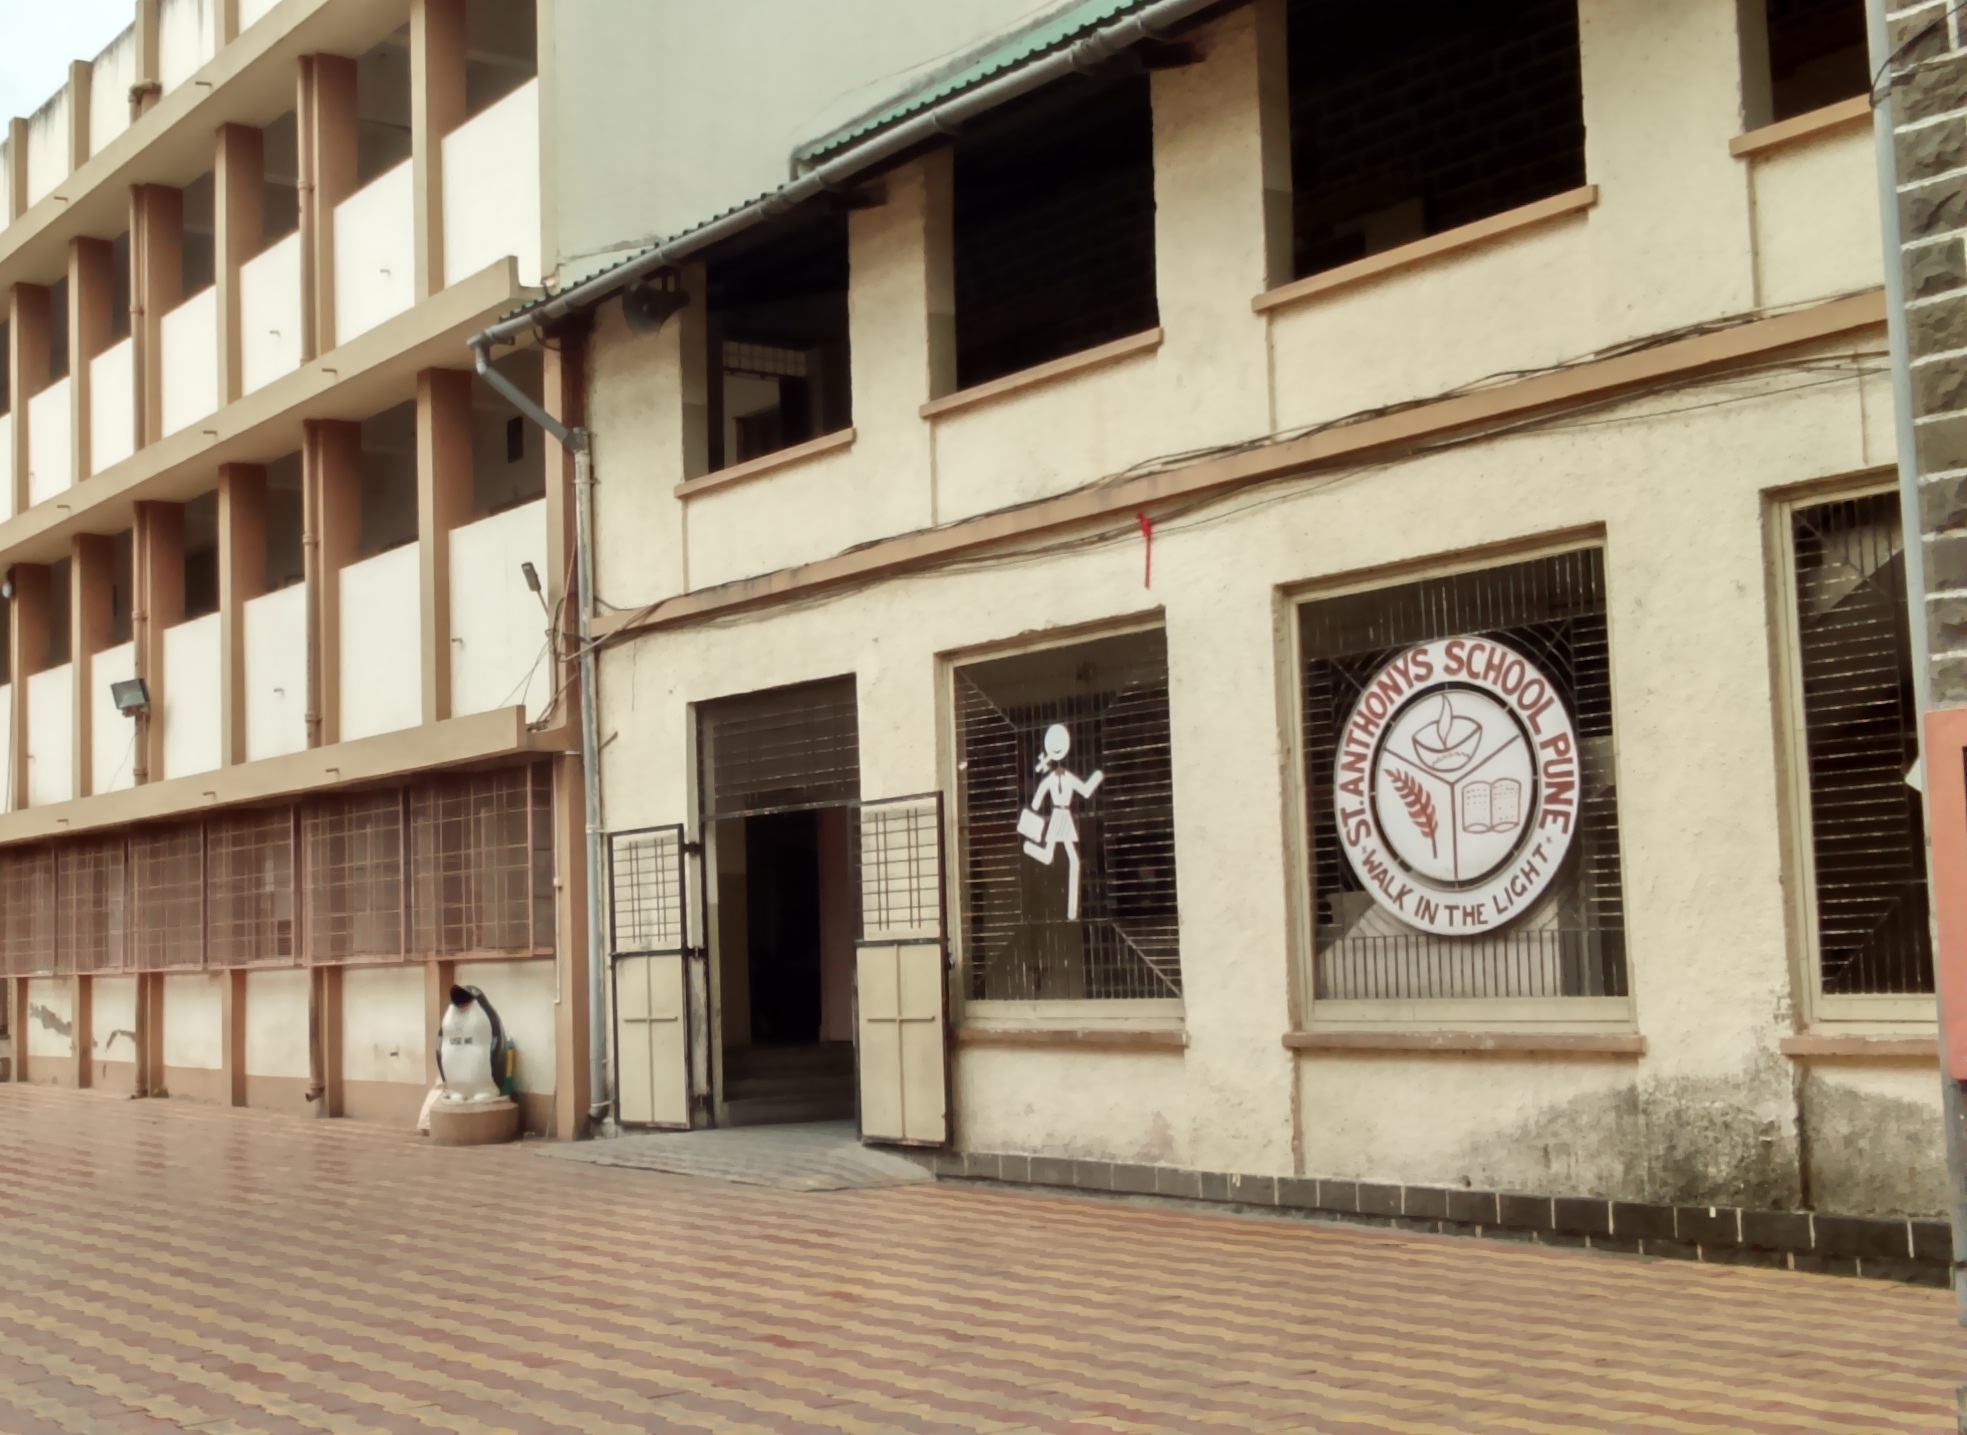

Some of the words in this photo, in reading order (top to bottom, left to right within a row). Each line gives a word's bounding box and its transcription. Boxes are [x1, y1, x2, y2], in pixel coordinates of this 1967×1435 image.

[1442, 640, 1555, 735] SCHOOL
[1538, 731, 1576, 835] PUNE
[1361, 848, 1415, 912] WALK
[1414, 895, 1440, 926] IN
[1443, 903, 1489, 928] THE
[1491, 843, 1550, 916] LIGHT
